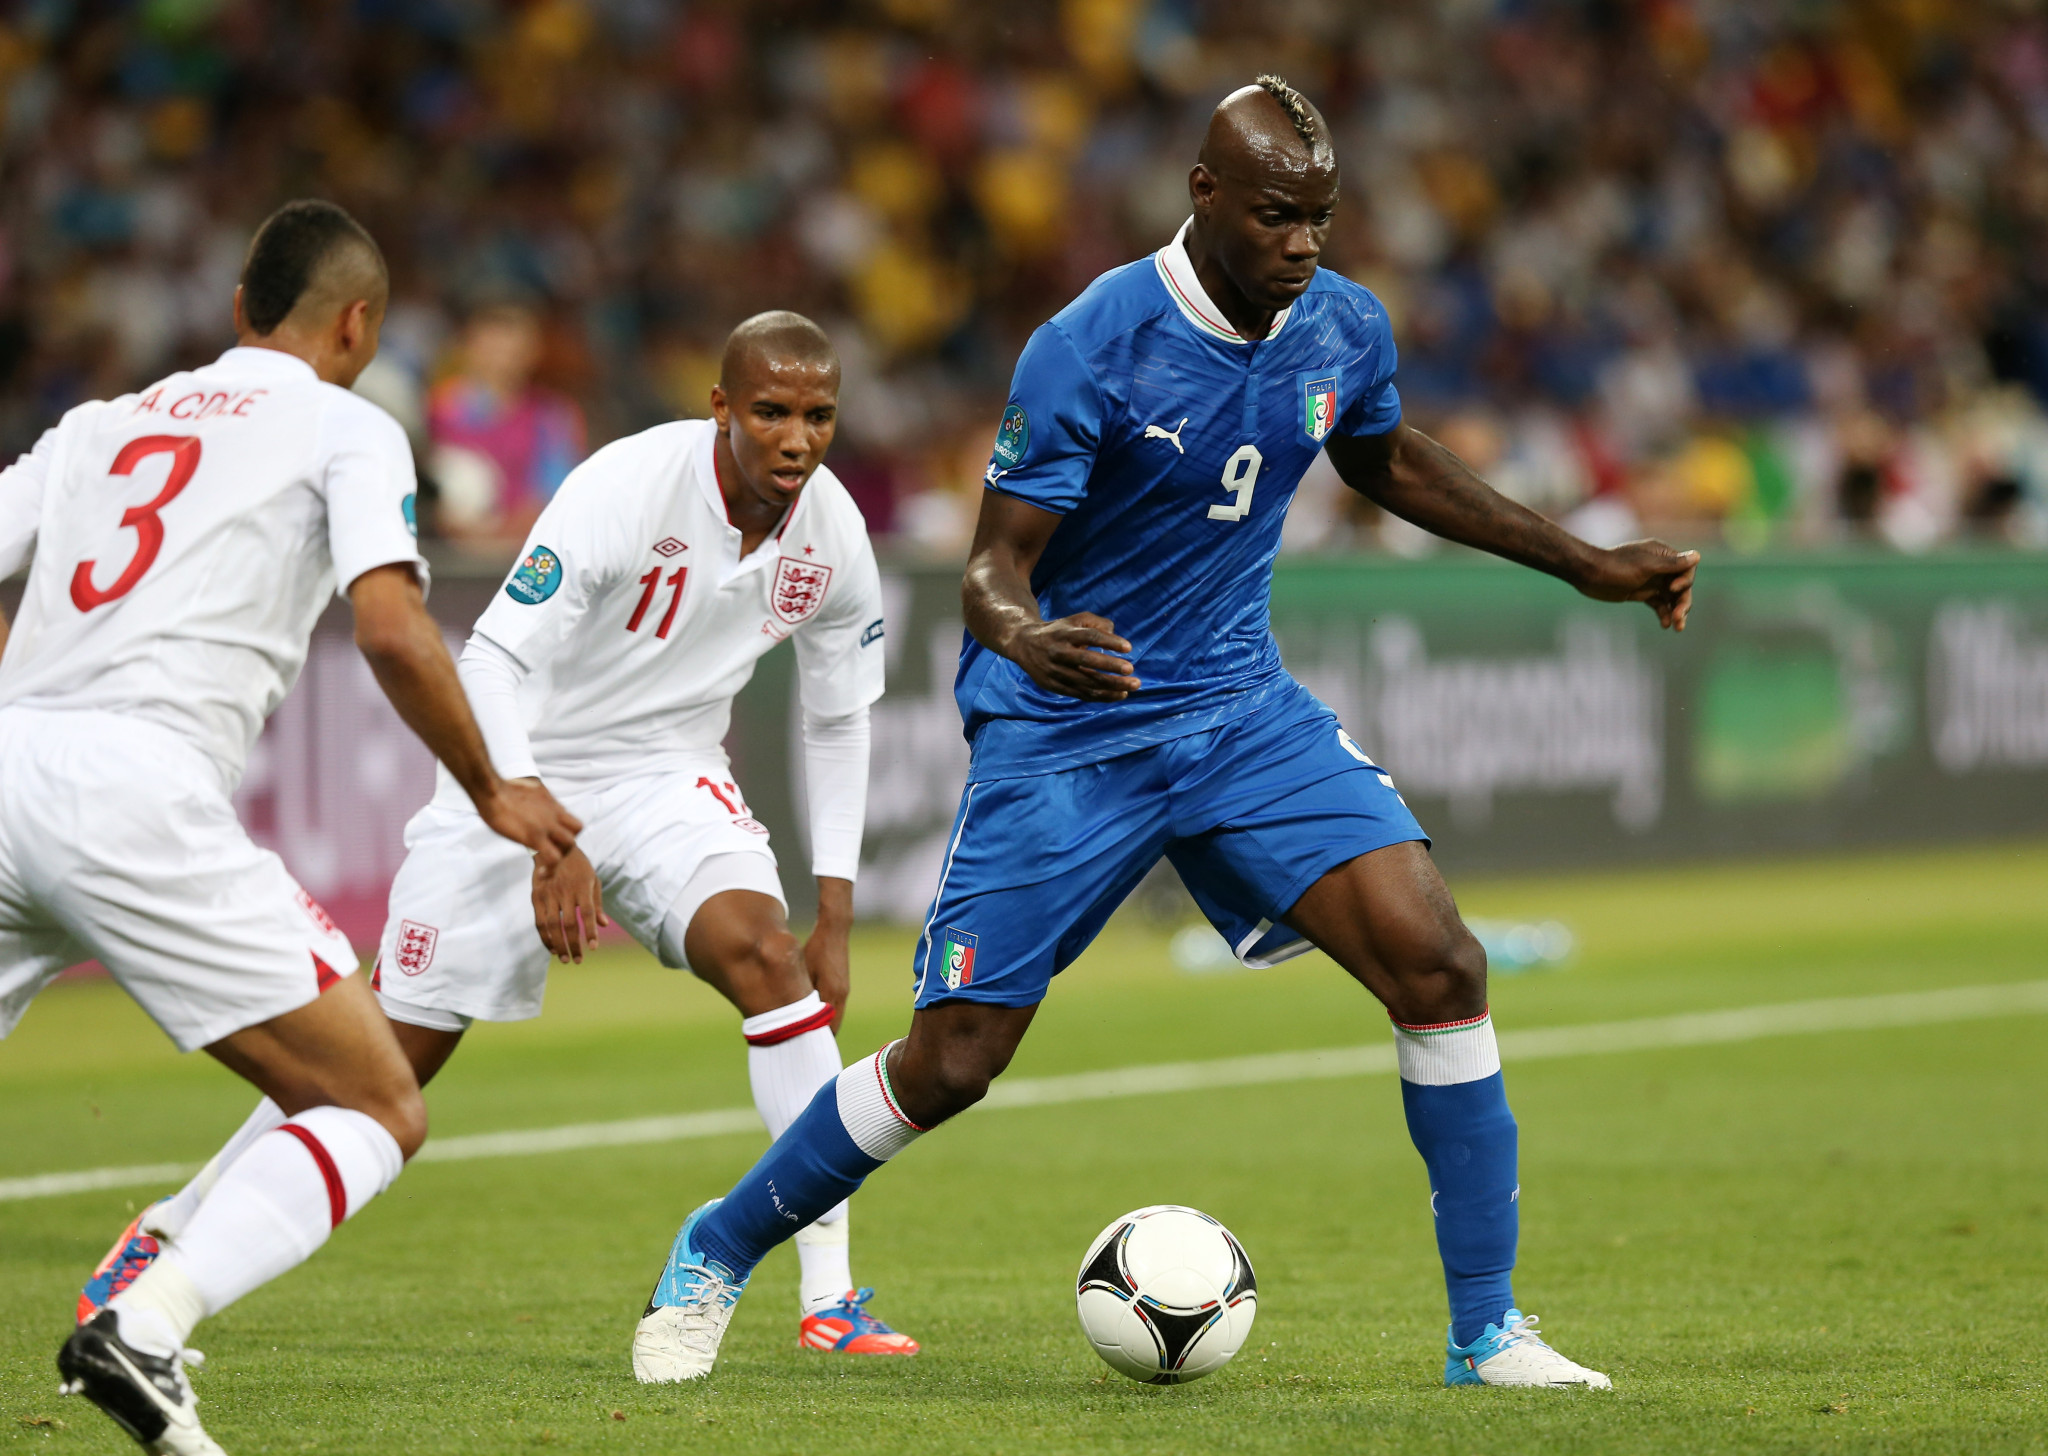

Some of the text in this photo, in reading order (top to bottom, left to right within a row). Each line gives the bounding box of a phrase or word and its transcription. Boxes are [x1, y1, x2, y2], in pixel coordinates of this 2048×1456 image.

[133, 387, 161, 414] A.
[1309, 382, 1333, 393] ITALIA
[1206, 444, 1264, 522] 9
[69, 434, 203, 613] 3
[625, 566, 689, 640] 11
[949, 931, 973, 946] ITALIA
[766, 1179, 799, 1222] ITALIA
